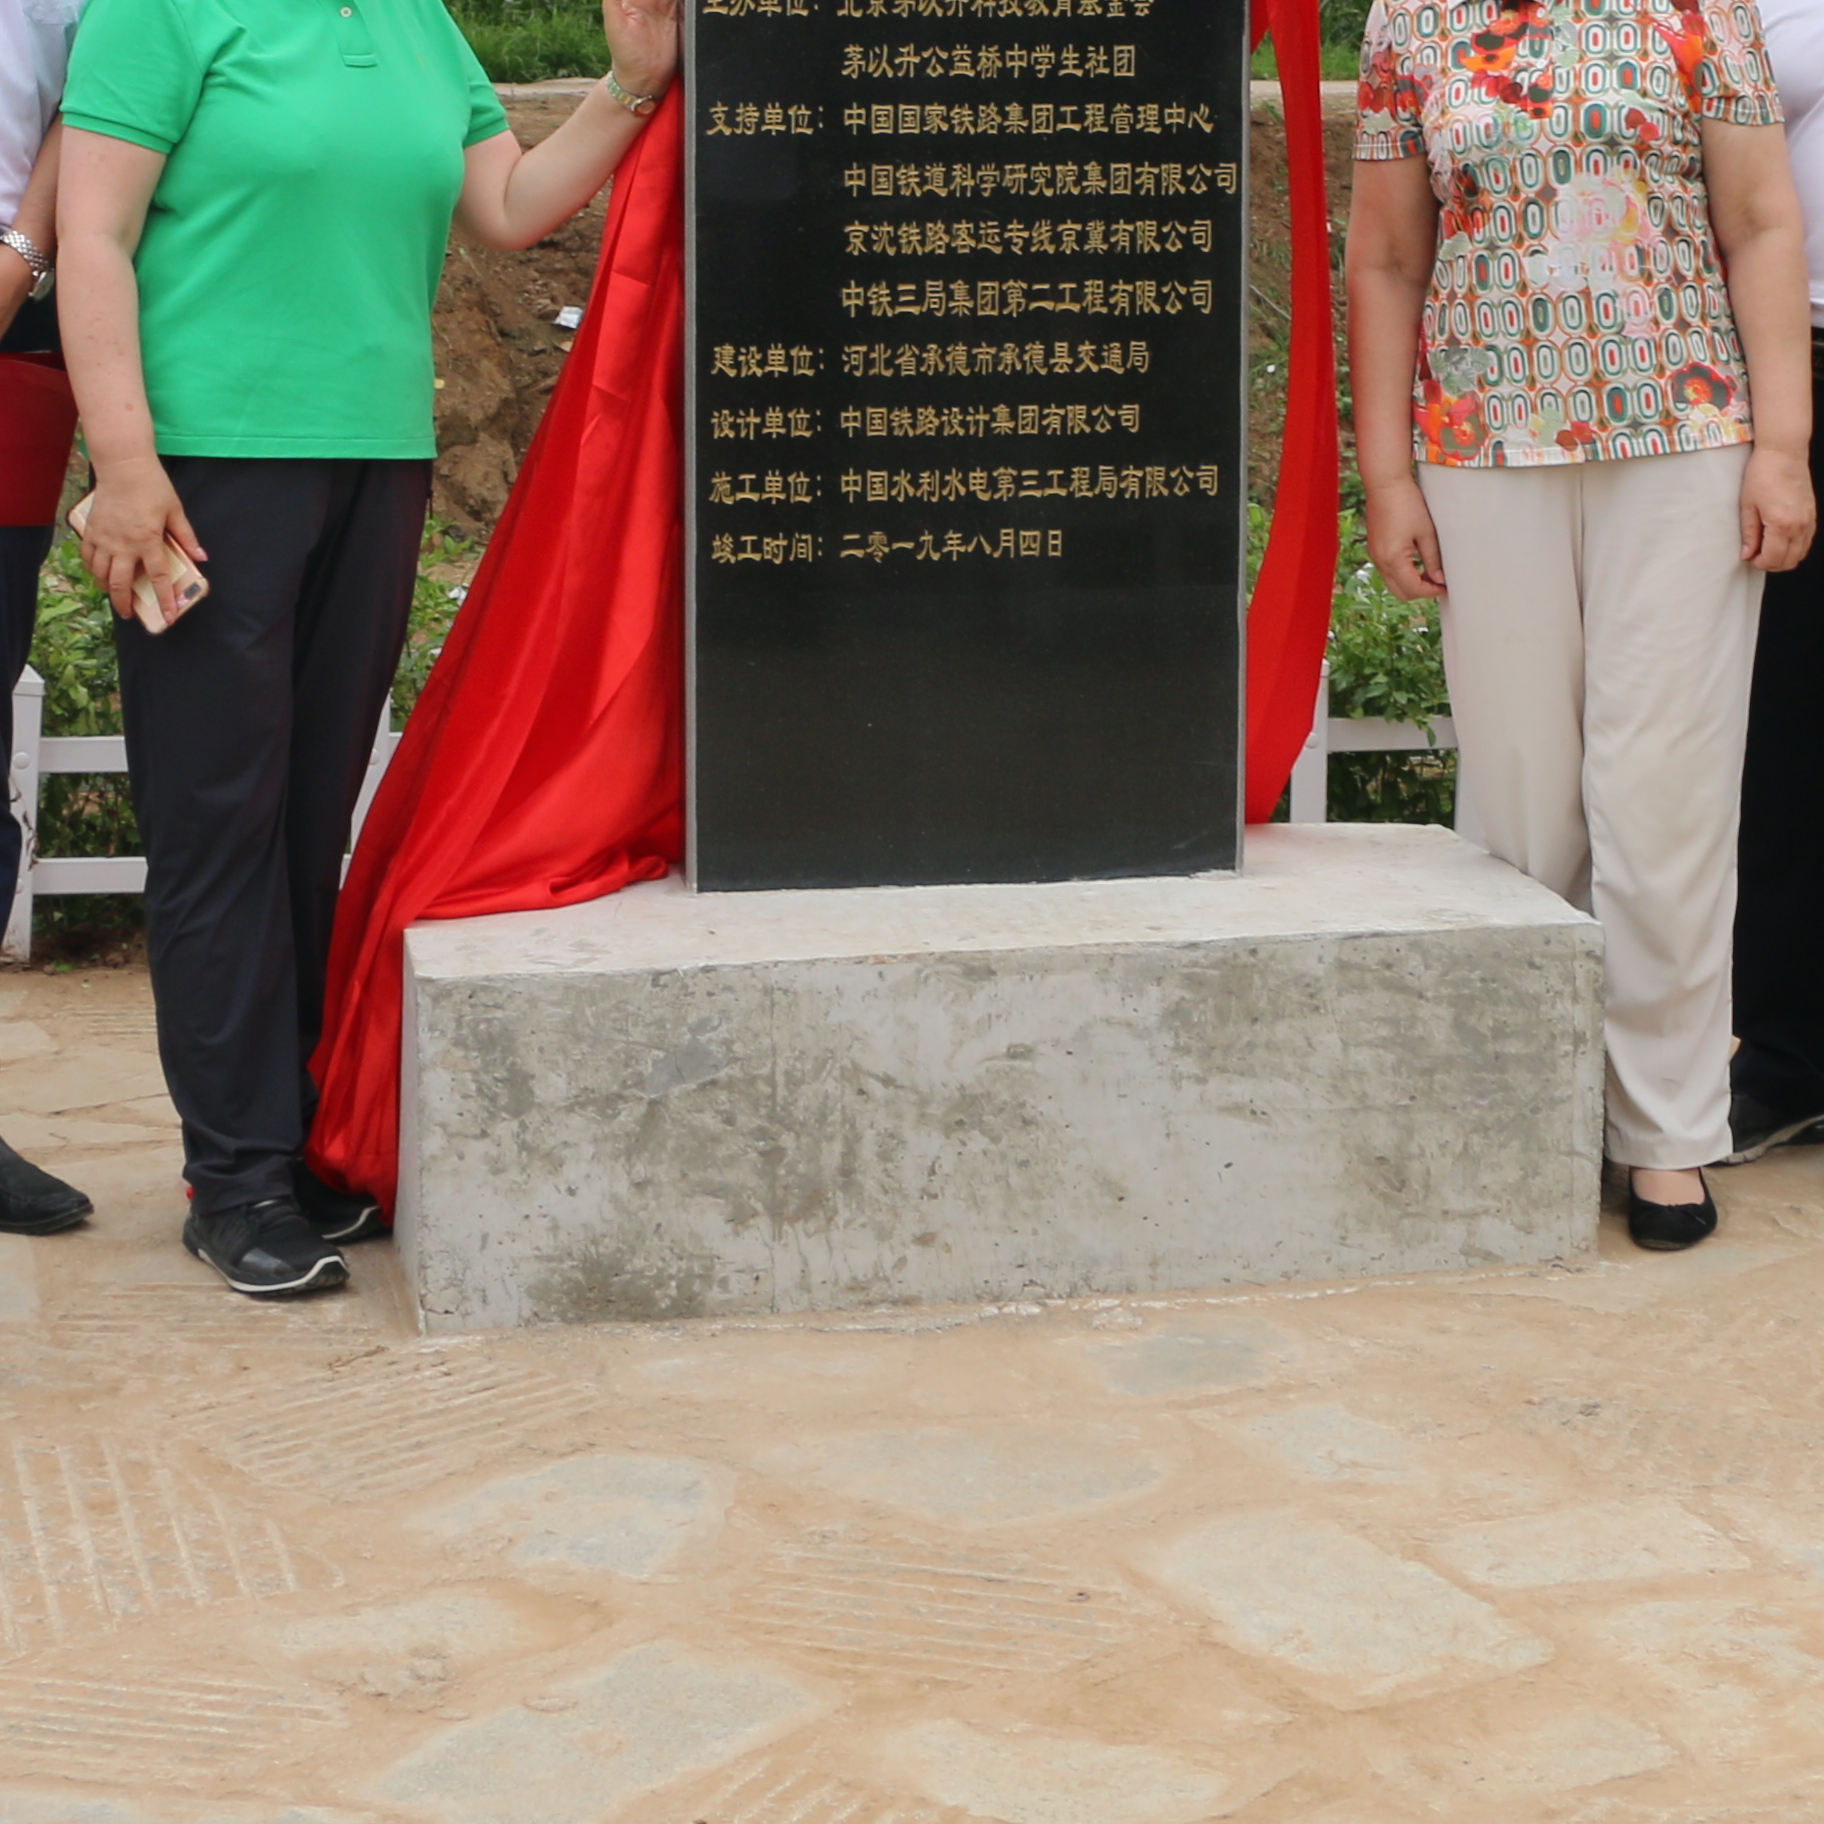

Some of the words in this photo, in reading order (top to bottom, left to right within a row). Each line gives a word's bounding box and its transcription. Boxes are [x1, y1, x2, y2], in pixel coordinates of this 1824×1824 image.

[841, 44, 1137, 79] 茅以升公益桥中学生社团
[706, 102, 825, 136] 支持单位：
[843, 102, 1215, 136] 中国国家铁路集团工程管理中心
[843, 161, 1238, 197] 中国铁道科学研究院集团有限公司
[843, 219, 1214, 256] 京沈铁路客运专线京冀有限公司
[841, 279, 1214, 318] 中铁三局集团第二工程有限公司
[710, 342, 824, 378] 建设单位：
[841, 341, 1150, 377] 河北省承德市承德县交通局
[710, 407, 823, 439] 设计单位：
[840, 404, 1142, 438] 中国铁路设计集团有限公司
[709, 470, 823, 505] 施工单位：
[840, 464, 1220, 504] 中国水利水电第三工程局有限公司
[710, 532, 823, 566] 竣工时间：
[839, 528, 1064, 564] 二零一九年八月四日
